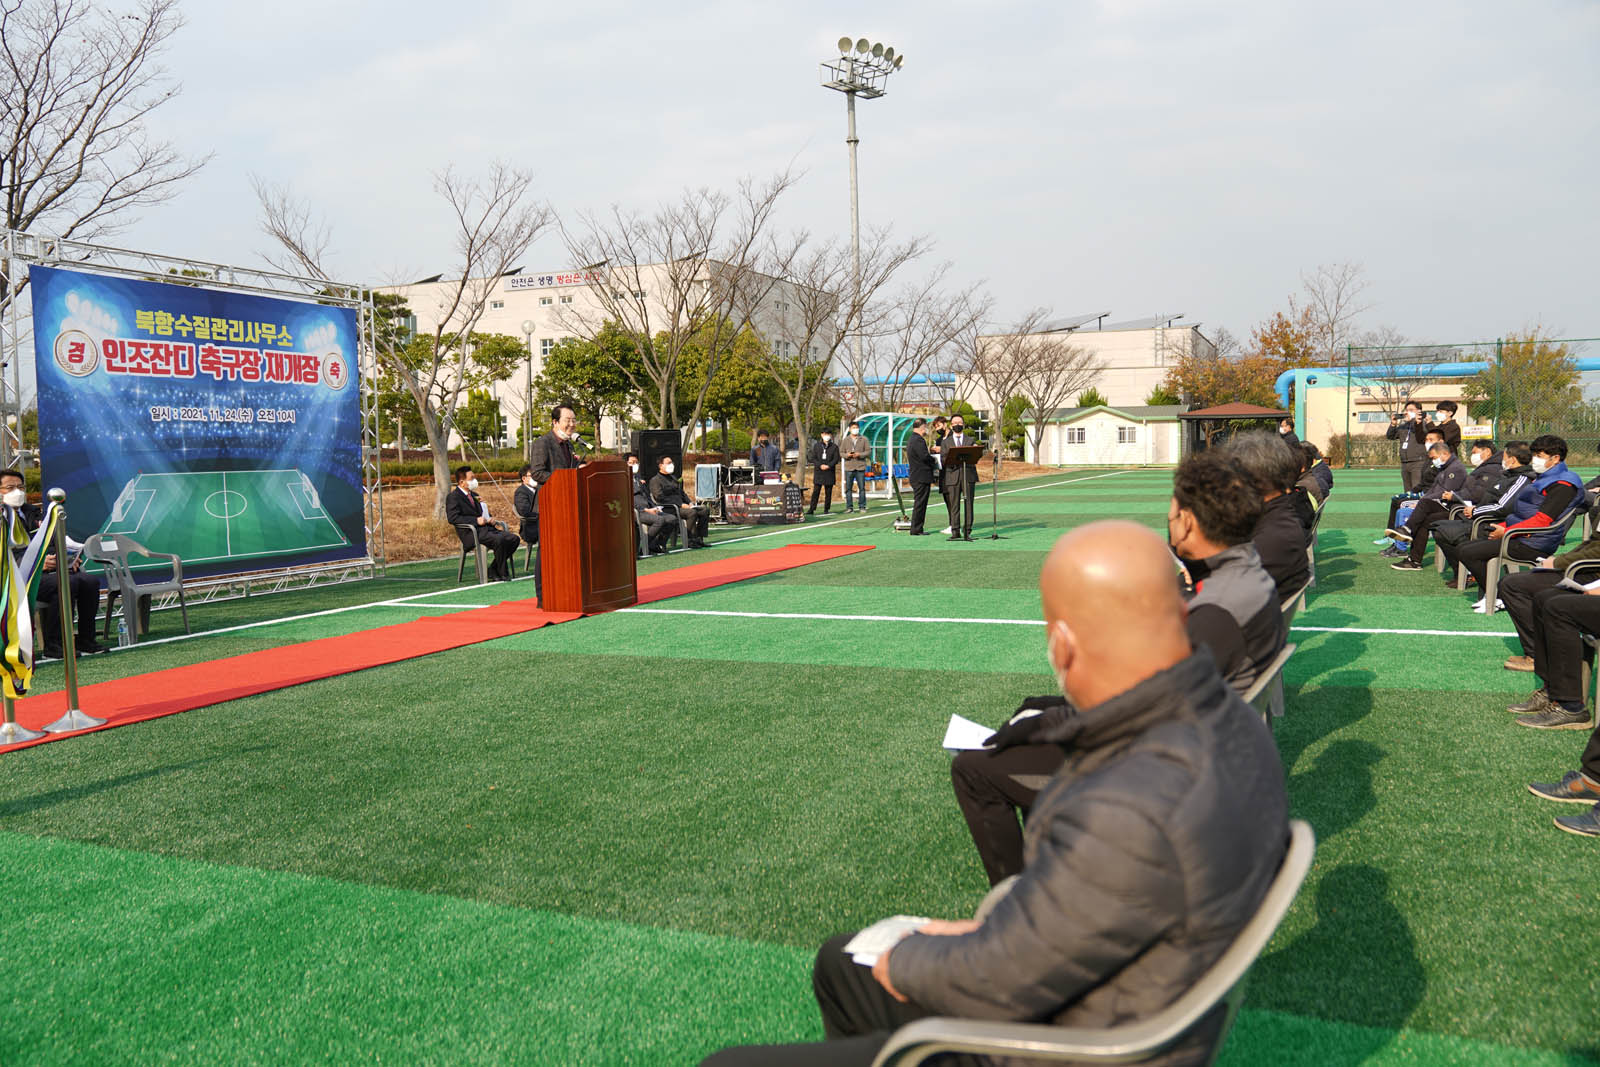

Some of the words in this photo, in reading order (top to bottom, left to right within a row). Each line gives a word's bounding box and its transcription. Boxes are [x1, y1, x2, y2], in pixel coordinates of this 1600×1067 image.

[511, 277, 534, 288] 안전은
[538, 275, 553, 286] 생명
[135, 309, 293, 347] 북항수질관리사무소
[67, 340, 86, 364] 경
[101, 338, 195, 377] 인조잔디
[199, 345, 262, 380] 축구장
[264, 351, 321, 384] 재개장
[329, 360, 341, 380] 축
[151, 407, 170, 421] 일시
[181, 408, 207, 421] 2021.
[209, 408, 223, 421] 11.
[257, 409, 276, 423] 오전
[277, 410, 296, 423] 10시
